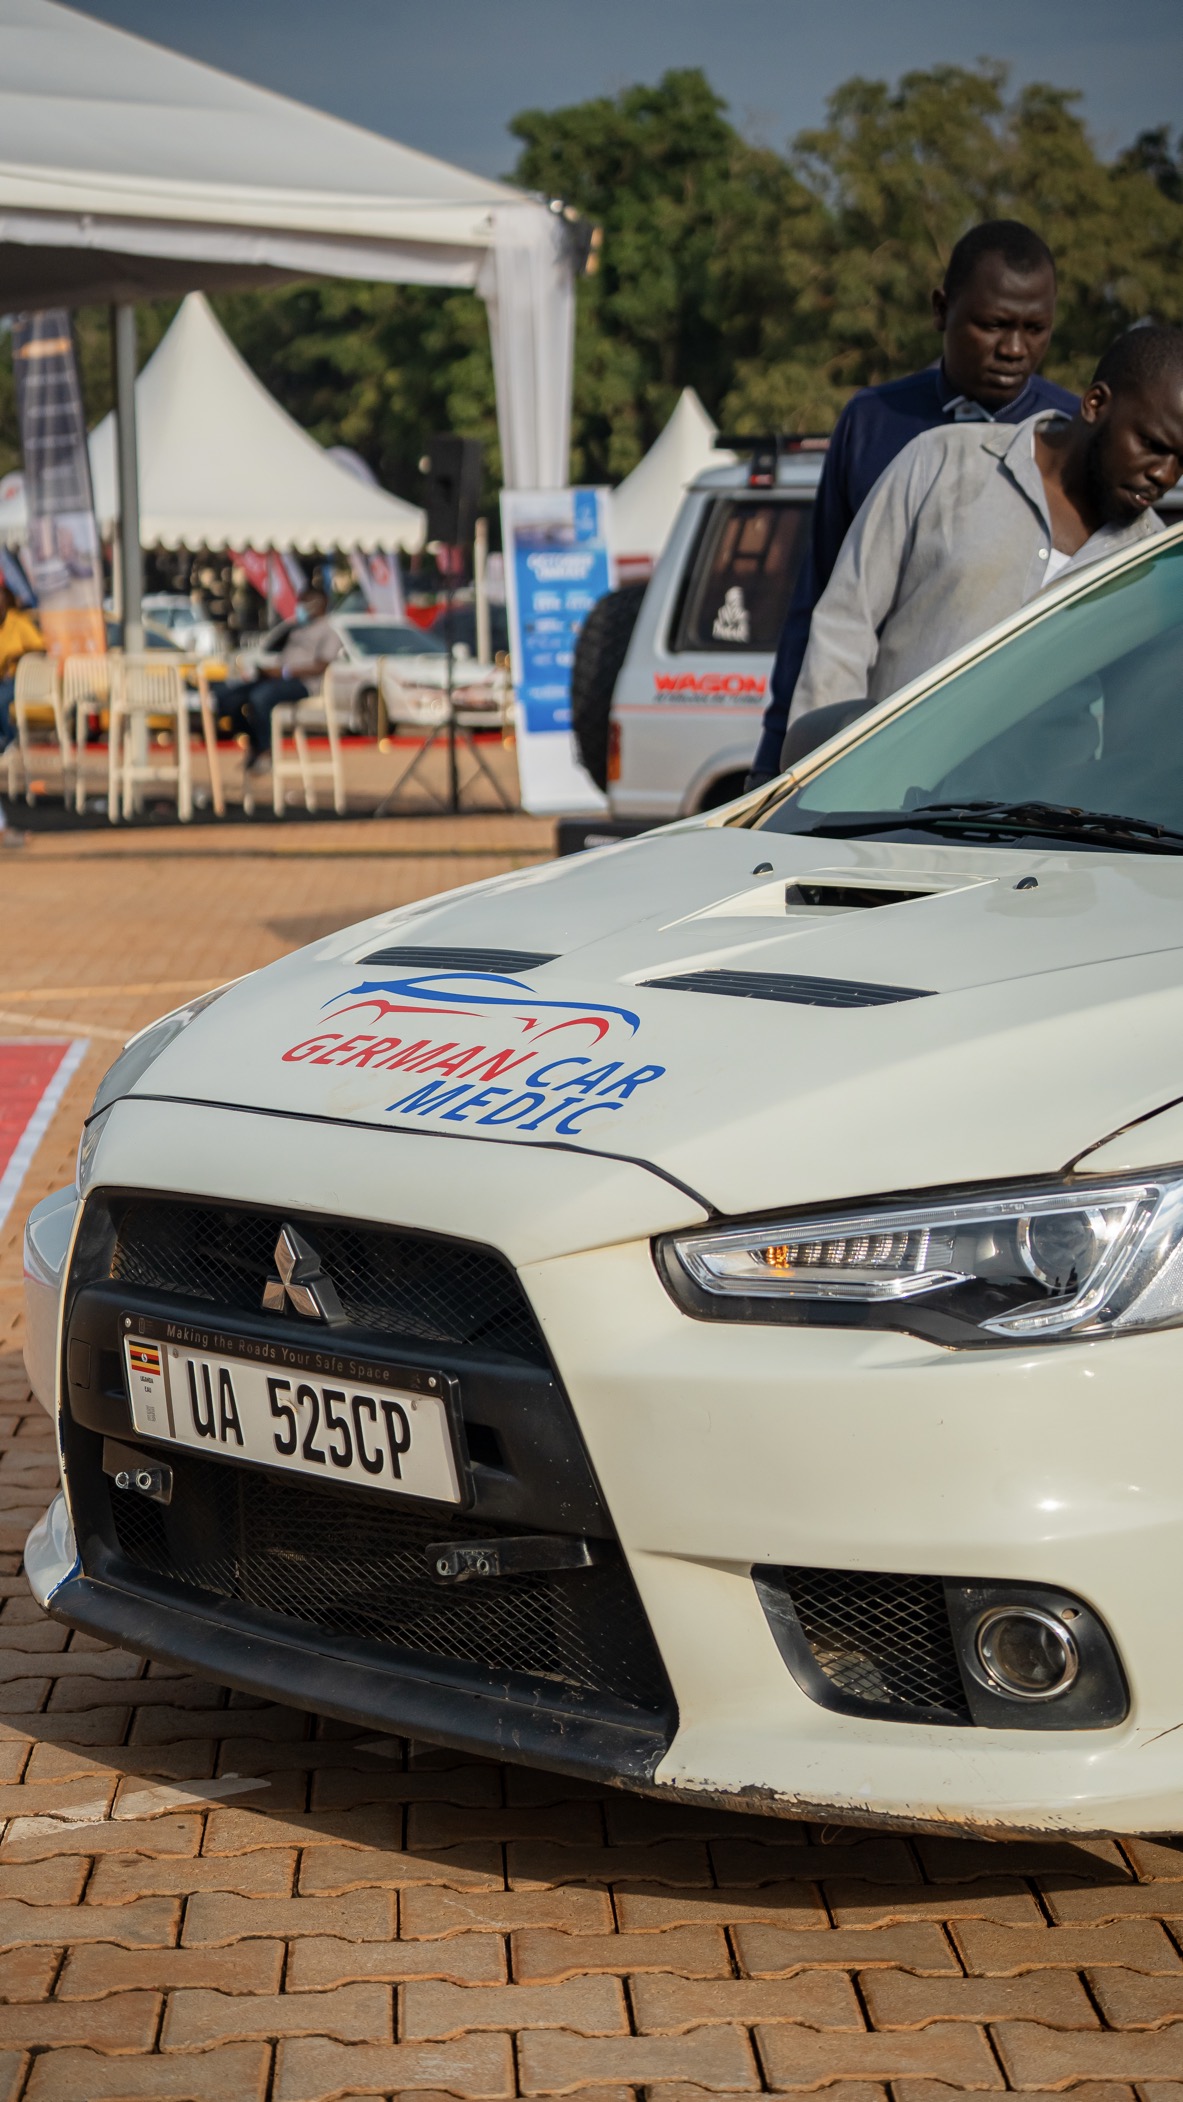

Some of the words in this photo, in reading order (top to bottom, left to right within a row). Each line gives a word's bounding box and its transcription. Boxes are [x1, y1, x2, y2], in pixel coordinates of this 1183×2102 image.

[653, 671, 768, 696] WAGON
[281, 1033, 539, 1082] GERMAN
[525, 1056, 667, 1099] CAR
[384, 1080, 625, 1135] MEDIC
[166, 1323, 209, 1348] Making
[213, 1334, 233, 1350] the
[239, 1340, 276, 1359] Roads
[281, 1347, 310, 1365] Your
[315, 1354, 344, 1372] Safe
[349, 1361, 391, 1380] Space
[187, 1358, 245, 1446] UA
[267, 1375, 411, 1480] 525CP
